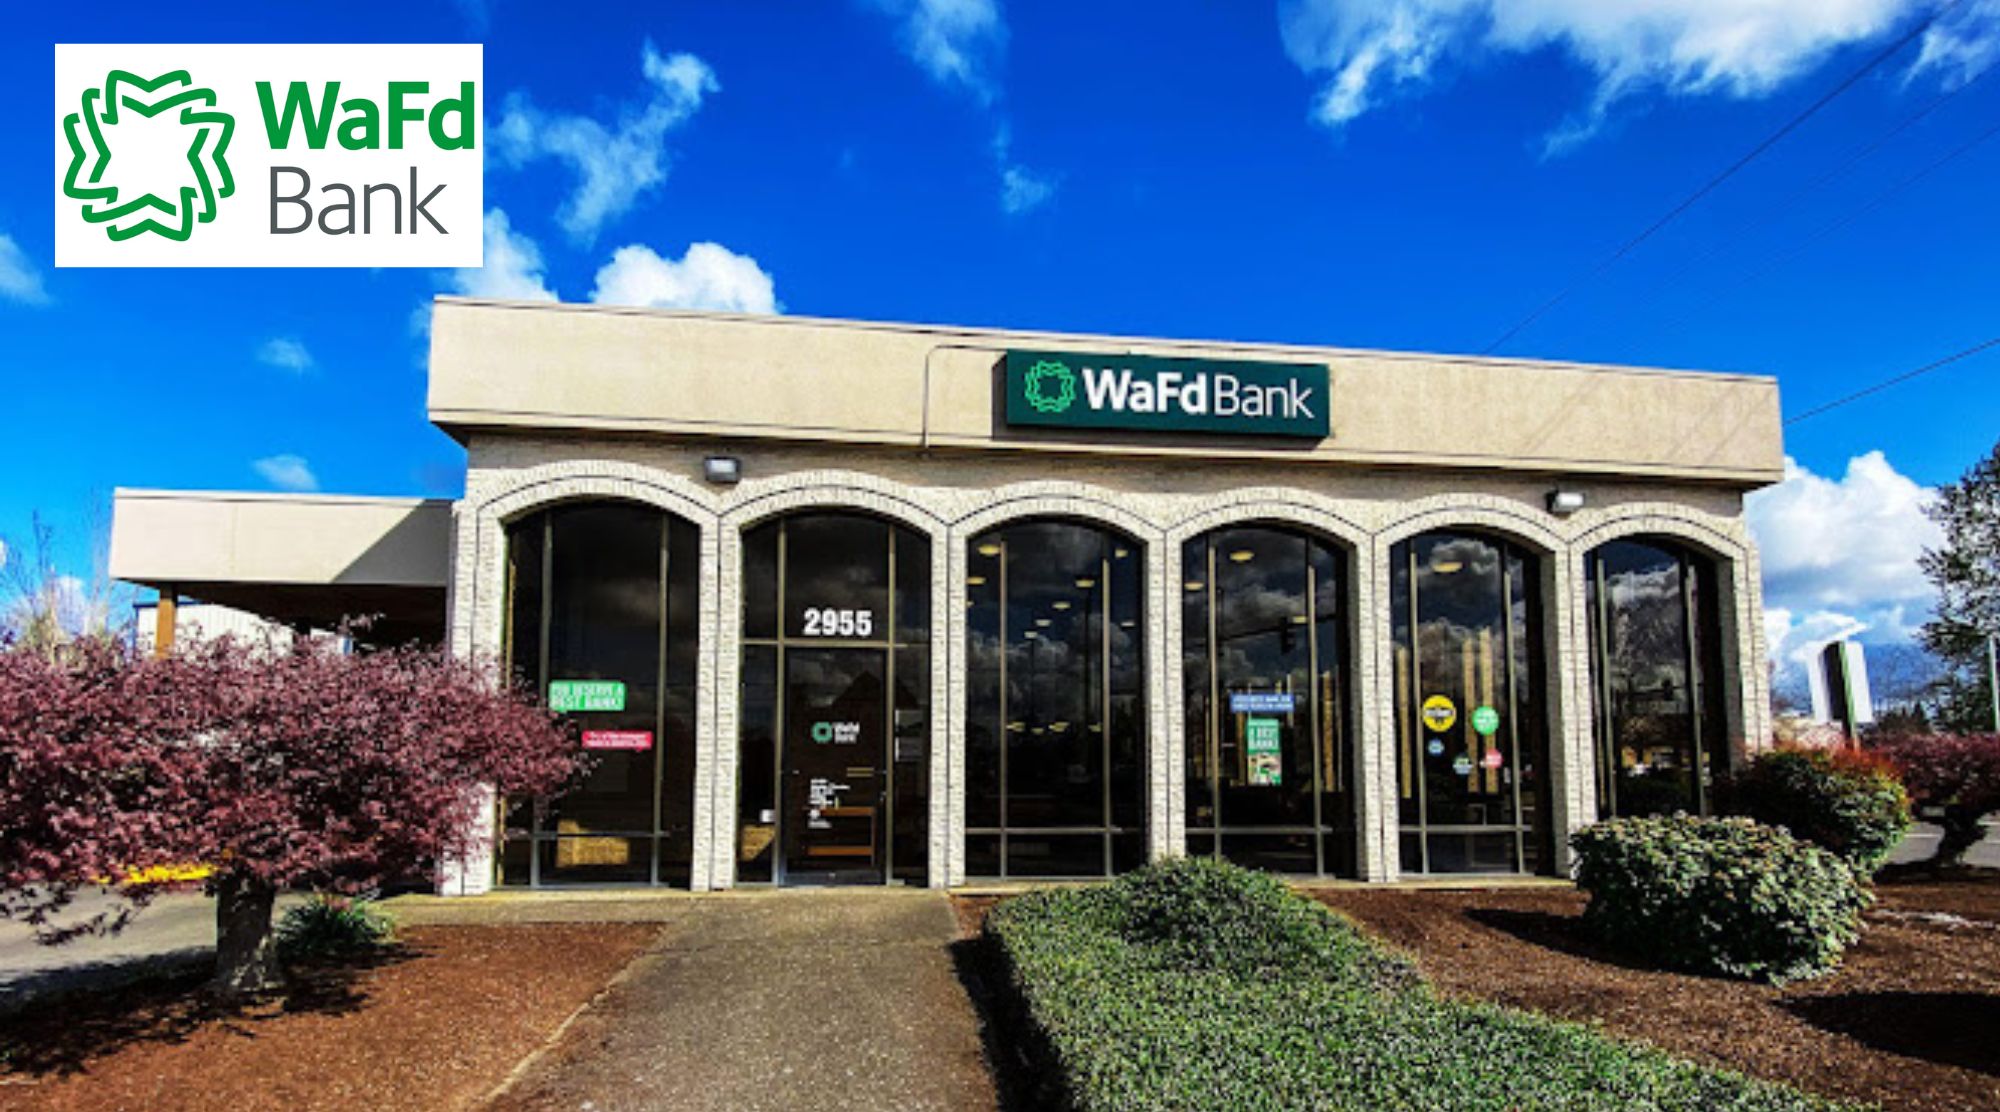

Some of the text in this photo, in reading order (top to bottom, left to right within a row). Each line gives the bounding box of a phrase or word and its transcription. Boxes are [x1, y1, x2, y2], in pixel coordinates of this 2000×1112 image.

[1082, 367, 1316, 419] WaFd Bank
[803, 607, 872, 636] 2955
